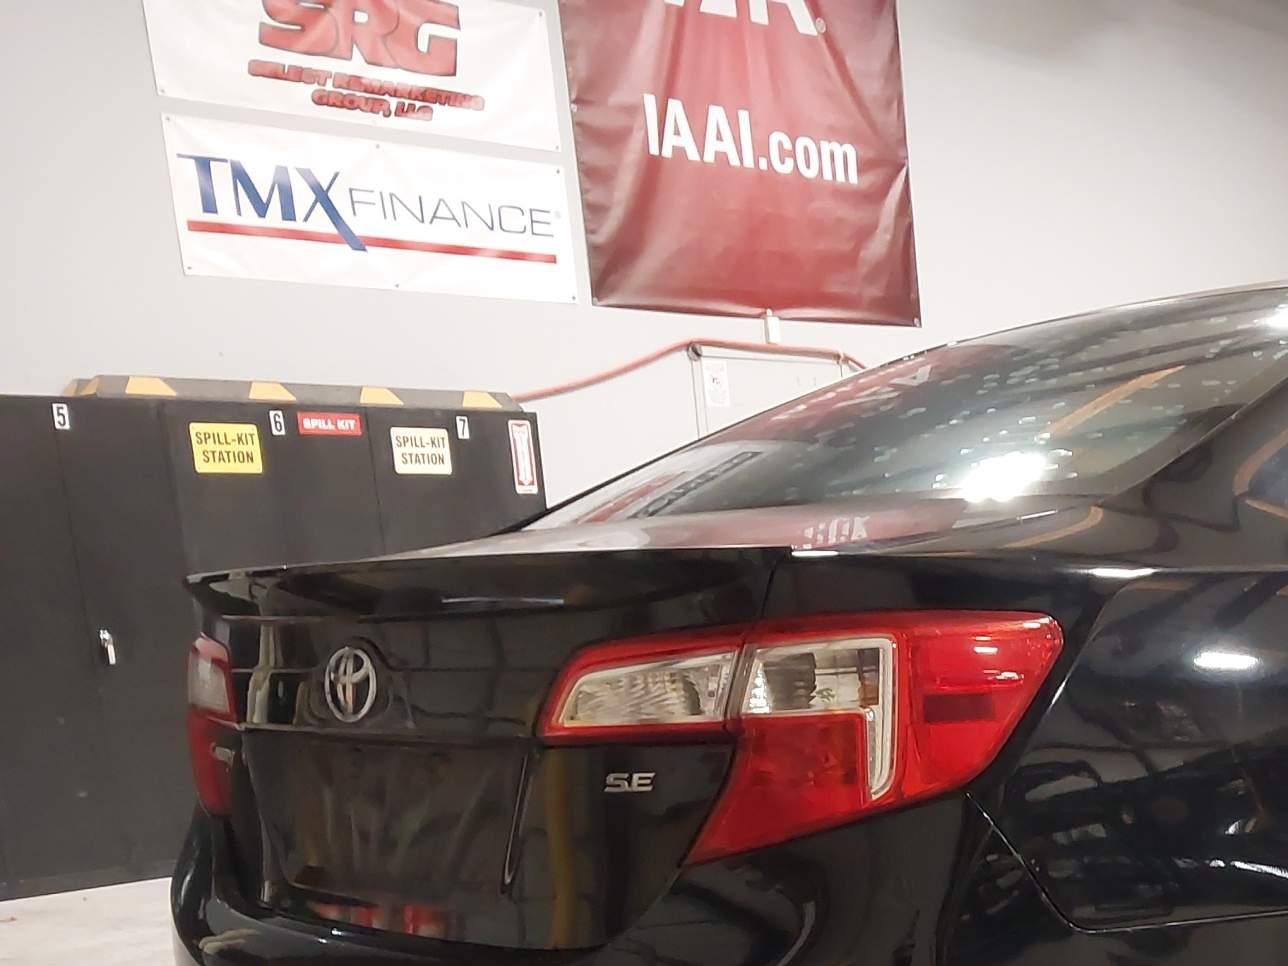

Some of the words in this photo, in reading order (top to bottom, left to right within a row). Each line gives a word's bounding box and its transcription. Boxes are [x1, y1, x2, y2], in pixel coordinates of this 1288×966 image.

[259, 0, 461, 77] SRG
[643, 93, 858, 184] IAAI.com
[176, 153, 368, 252] TMX
[348, 187, 555, 238] FINANCE
[56, 406, 66, 427] 5
[272, 413, 283, 432] 6
[303, 417, 335, 430] SPILL
[337, 419, 356, 431] KIT
[459, 418, 467, 437] 7
[195, 431, 256, 446] SPILL-KIT
[395, 435, 446, 449] SPILL-KIT
[202, 450, 254, 464] STATION
[402, 453, 445, 465] STATION
[604, 772, 656, 792] SE
